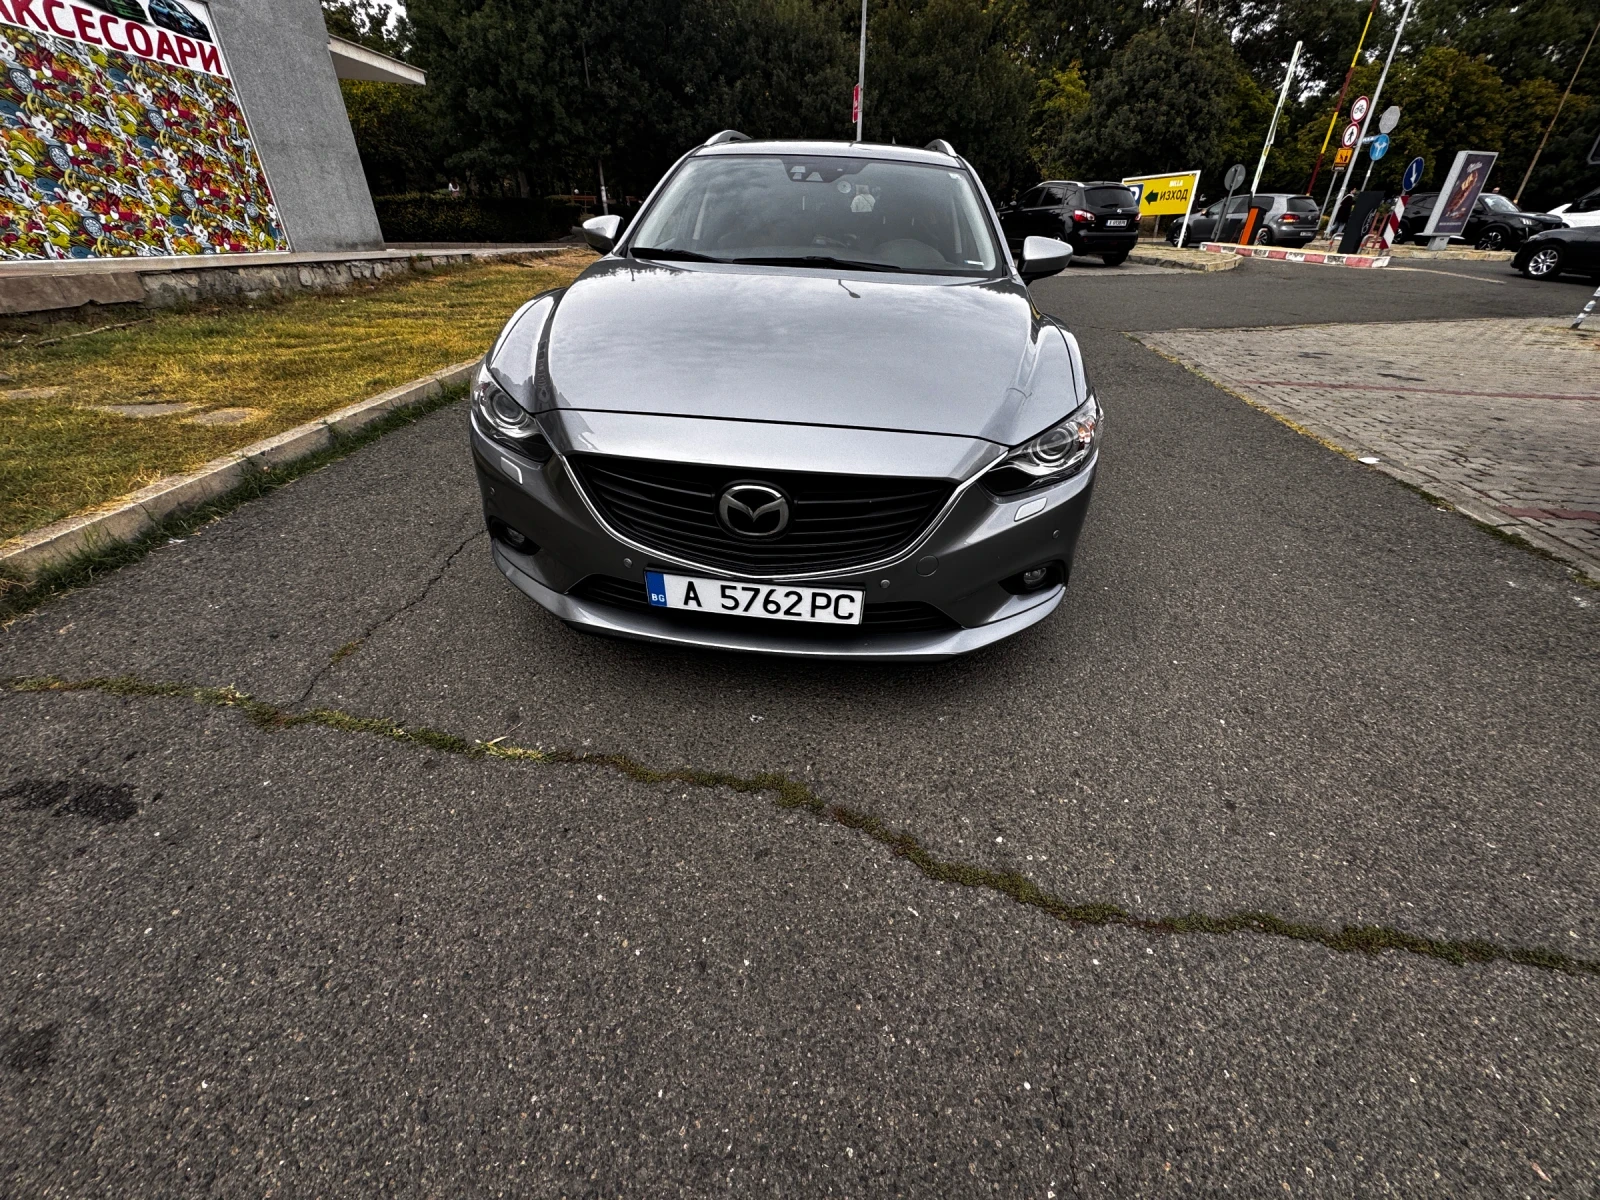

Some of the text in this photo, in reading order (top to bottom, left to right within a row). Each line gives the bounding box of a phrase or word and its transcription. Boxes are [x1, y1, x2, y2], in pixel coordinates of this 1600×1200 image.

[1160, 189, 1188, 202] ИЗХОД
[651, 593, 665, 602] BG
[683, 580, 855, 620] A 5762 PC
